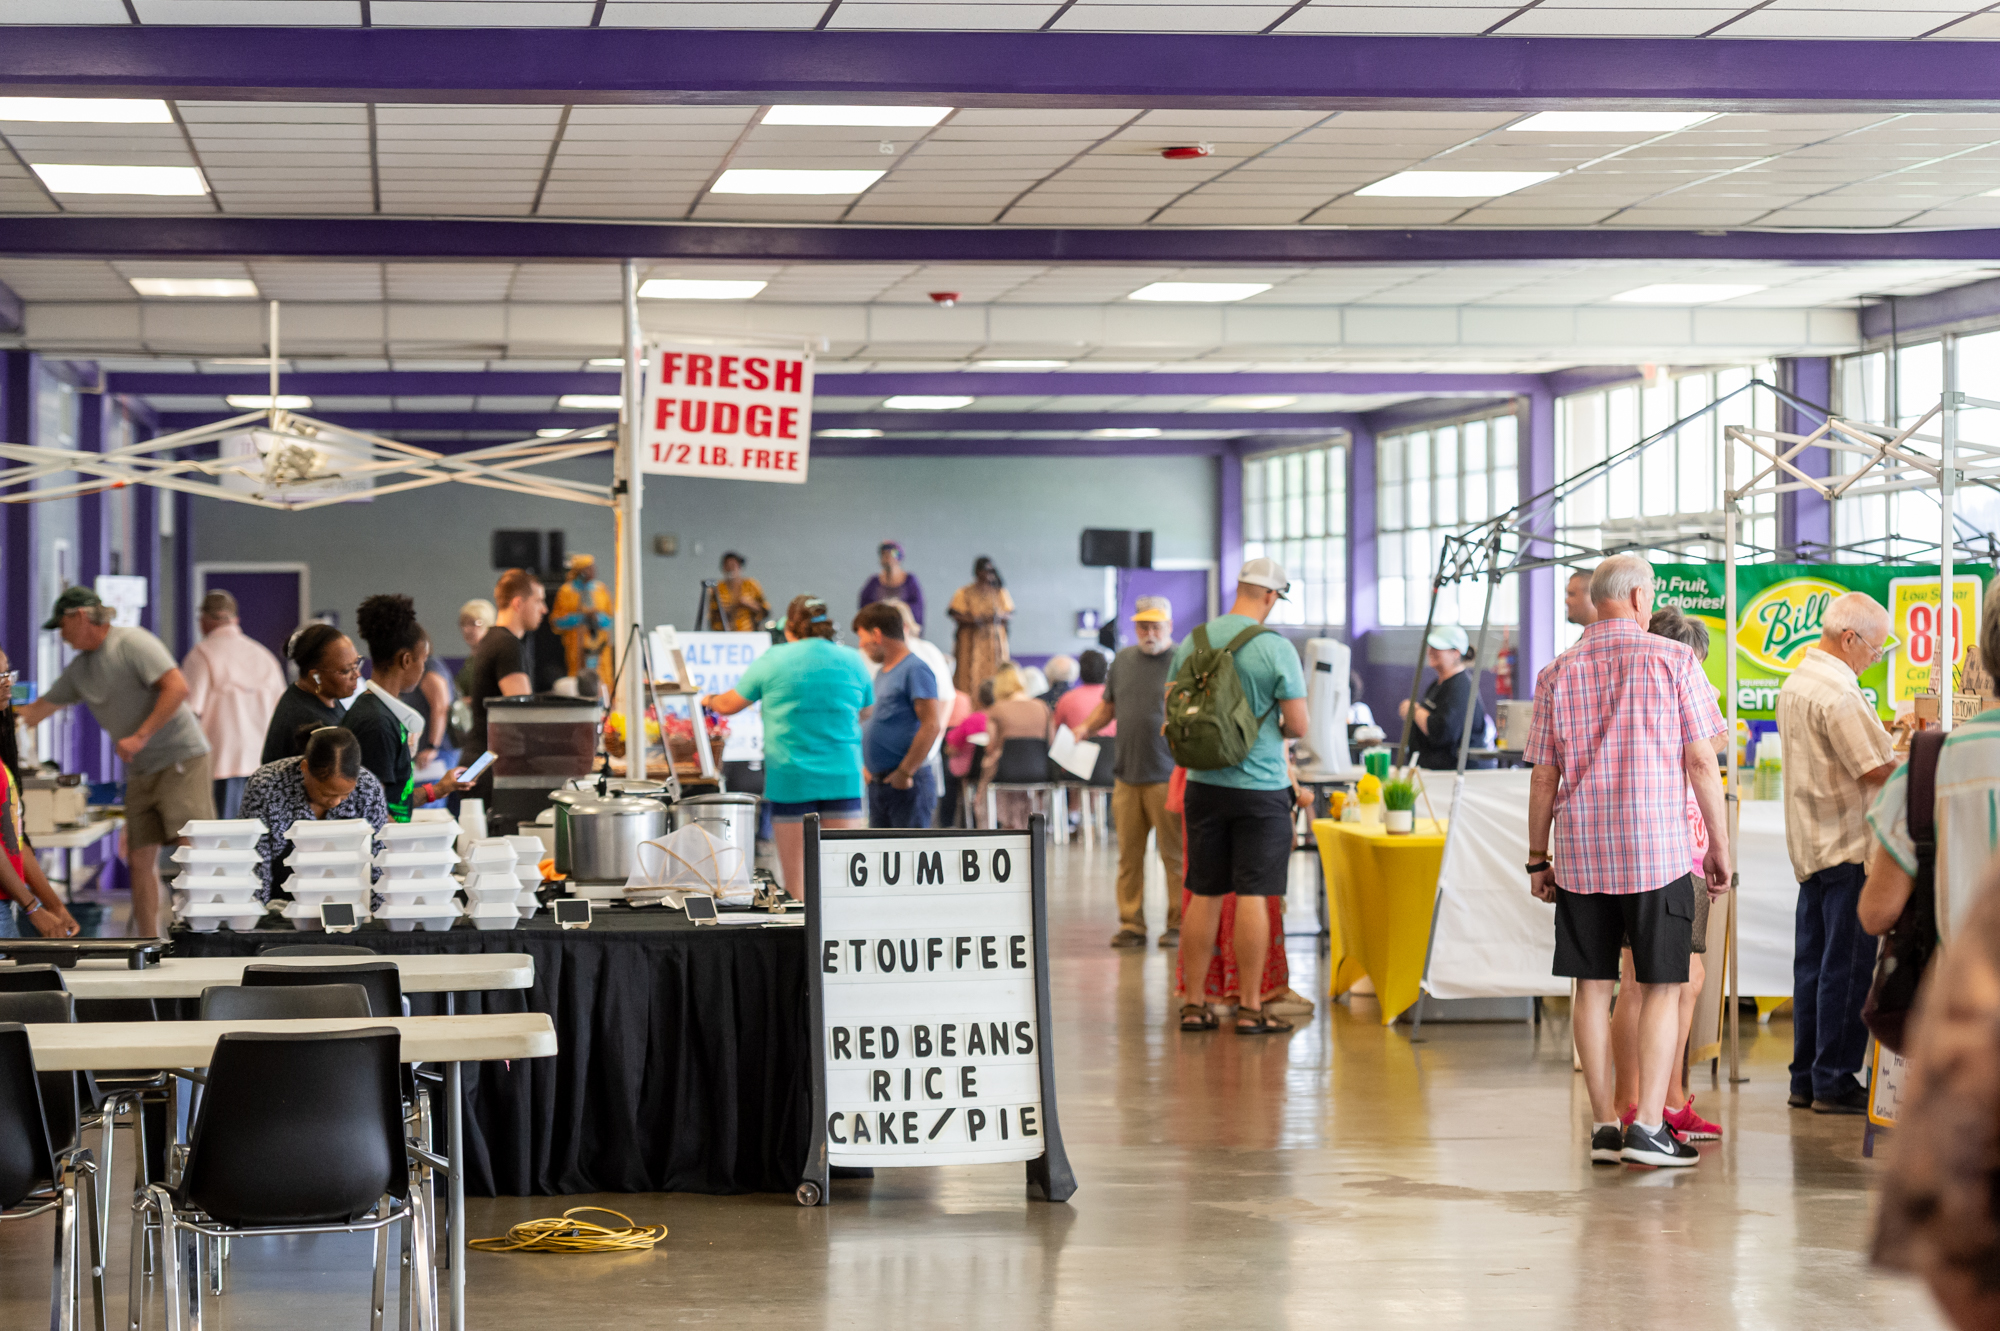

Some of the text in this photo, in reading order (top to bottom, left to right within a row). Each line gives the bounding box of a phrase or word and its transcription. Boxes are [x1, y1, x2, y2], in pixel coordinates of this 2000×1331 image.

[661, 352, 803, 394] FRESH
[655, 398, 799, 440] FUDGE
[650, 443, 799, 471] 1/2 LB. FREE
[1656, 592, 1726, 610] Calories!
[1669, 576, 1709, 595] Fruit,
[1902, 588, 1928, 601] Low
[681, 643, 755, 665] ALTED
[849, 848, 1012, 887] GUMBO
[822, 935, 1027, 974] ETOUFFEE
[832, 1021, 1035, 1060] RED BEANS
[873, 1065, 978, 1102] RICE
